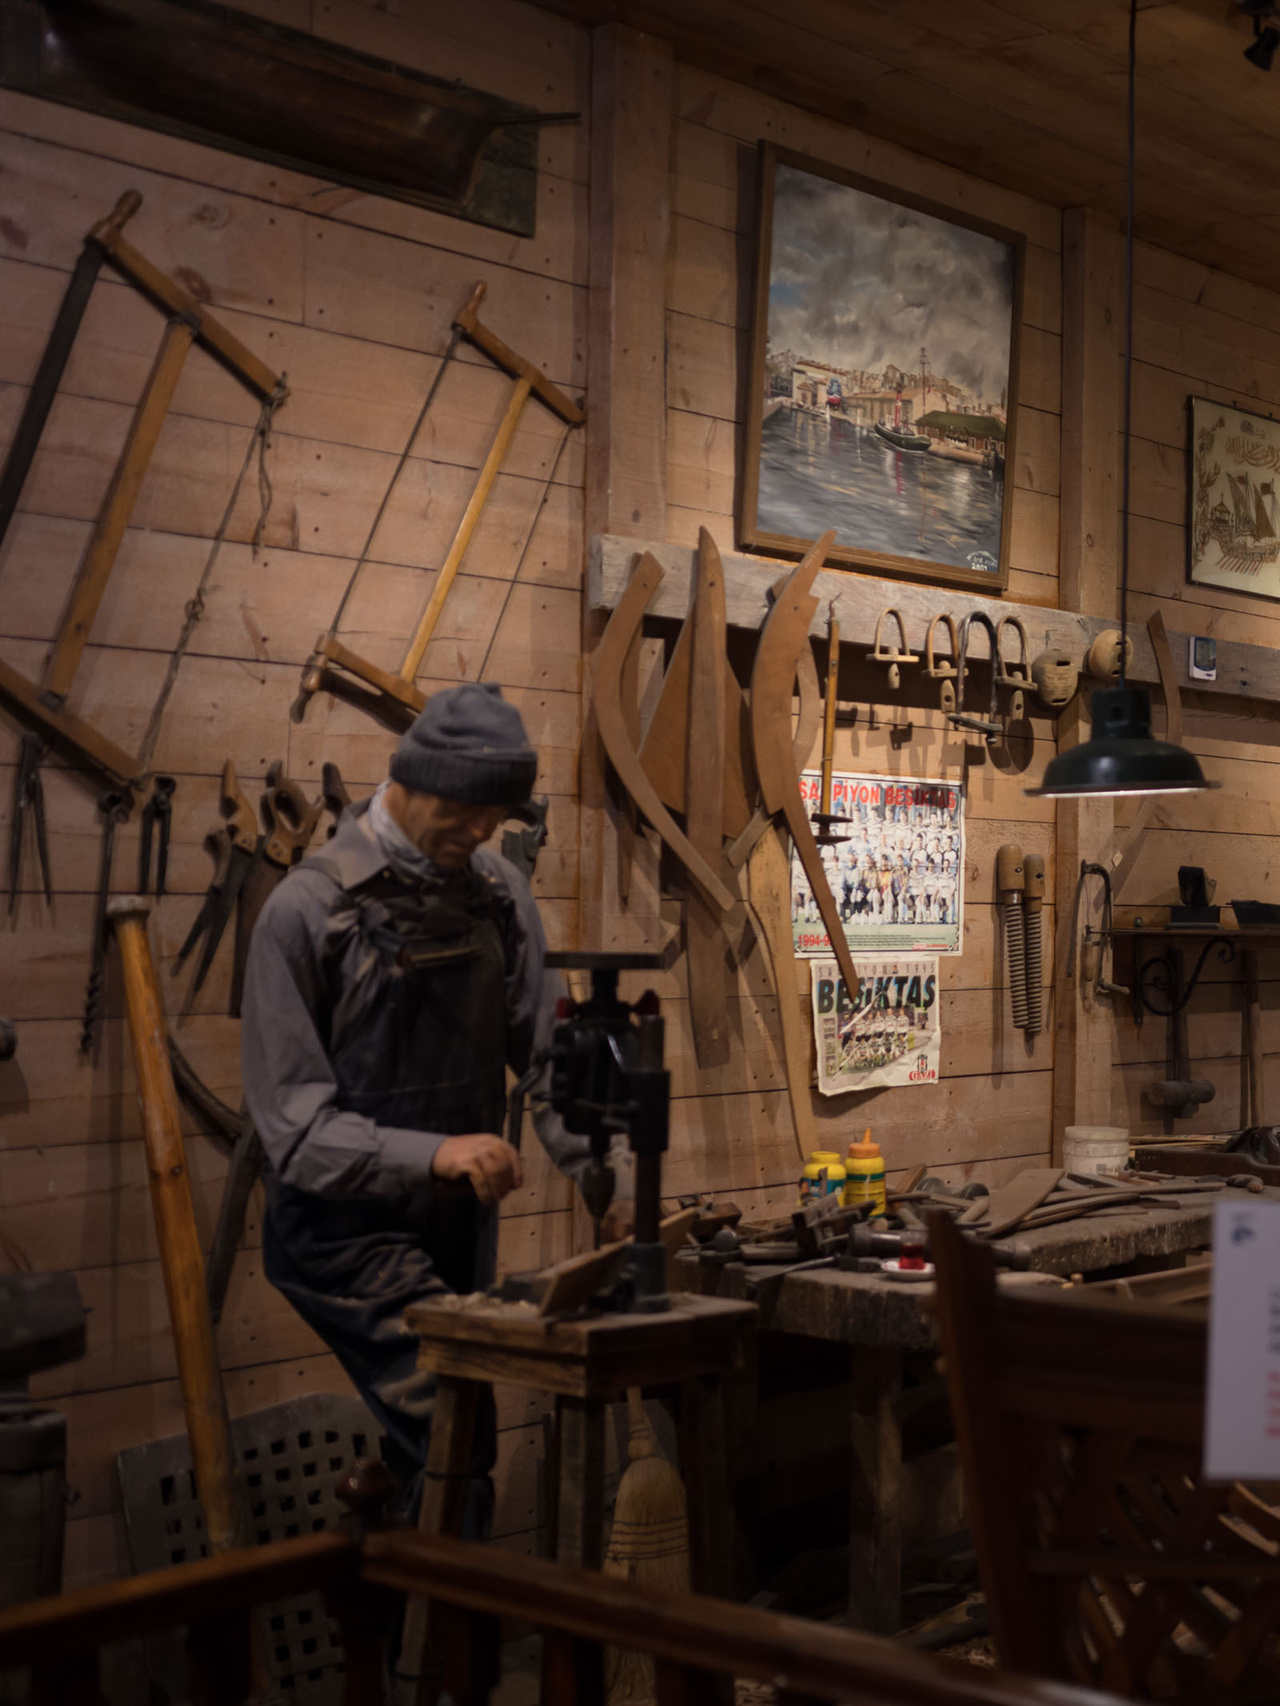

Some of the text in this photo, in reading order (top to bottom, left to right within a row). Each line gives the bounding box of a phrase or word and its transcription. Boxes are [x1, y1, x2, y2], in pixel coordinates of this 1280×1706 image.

[798, 780, 957, 812] ŞAPİYON BEŞİKTAŞ
[798, 934, 832, 947] 1994-9
